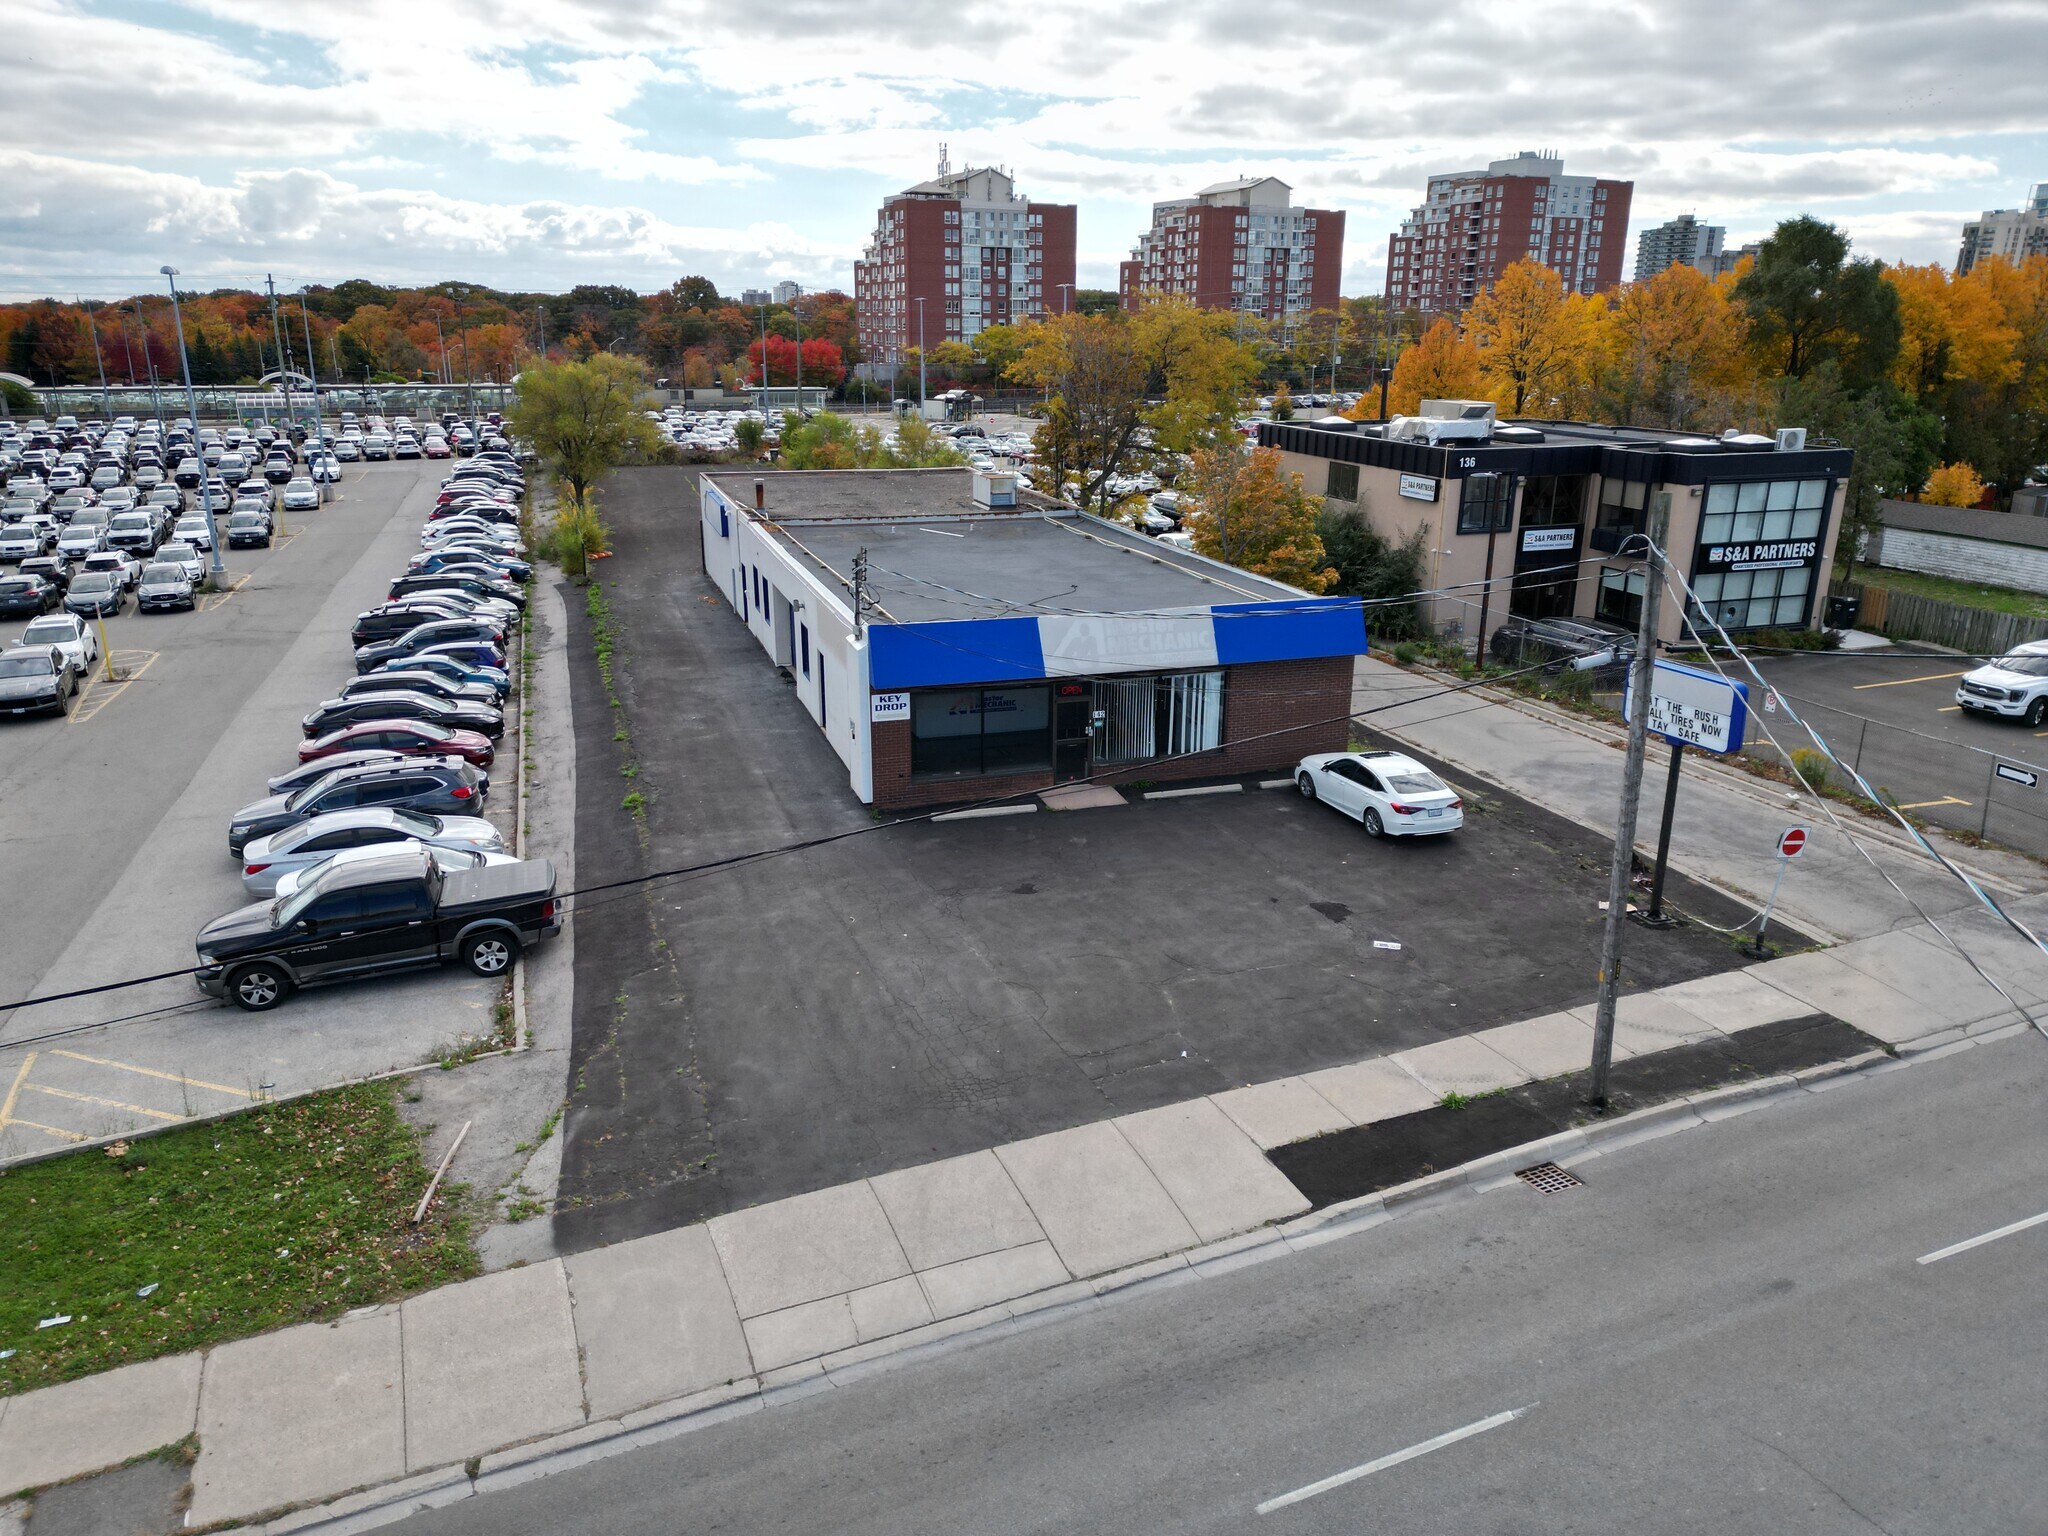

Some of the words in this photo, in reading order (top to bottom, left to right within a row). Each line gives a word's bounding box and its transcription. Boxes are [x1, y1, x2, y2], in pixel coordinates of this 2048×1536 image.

[1459, 457, 1476, 468] 136
[1407, 480, 1416, 489] S&A
[1415, 482, 1435, 492] PARTNERS
[1546, 533, 1573, 542] PARTNERS
[1724, 546, 1750, 562] S&A
[1753, 542, 1816, 560] PARTNERS
[1062, 686, 1082, 694] OPEN
[879, 695, 901, 703] KEY
[875, 703, 907, 711] DROP
[1667, 701, 1682, 714] THE
[1652, 719, 1669, 732] TAY
[1678, 727, 1700, 743] SAFE
[1670, 714, 1694, 729] TIRES
[1701, 723, 1722, 737] NOW
